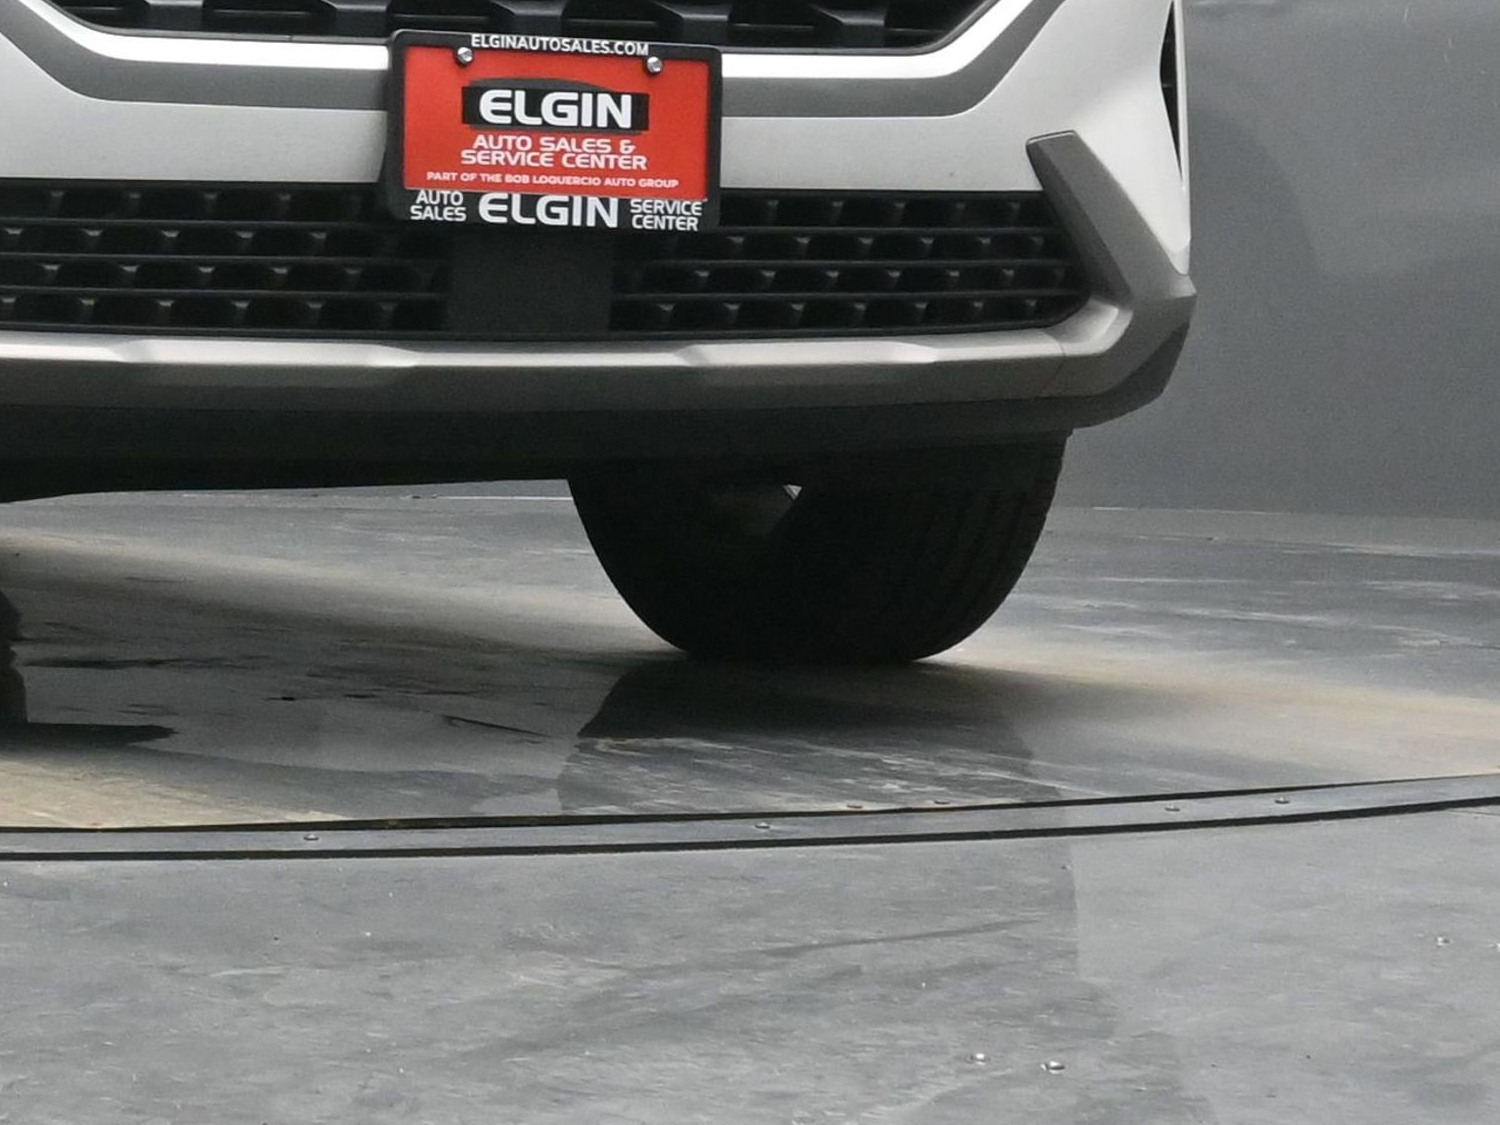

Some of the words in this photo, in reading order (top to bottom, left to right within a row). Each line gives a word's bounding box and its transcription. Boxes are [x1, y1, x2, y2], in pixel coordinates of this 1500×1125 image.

[471, 34, 649, 57] ELGINAUTOSALES.COM
[478, 88, 633, 130] ELGIN
[472, 134, 532, 151] AUTO
[539, 136, 612, 155] SALES
[619, 138, 636, 154] &
[460, 150, 555, 168] SERVICE
[561, 152, 648, 171] CENTER
[426, 171, 458, 182] PART
[460, 172, 477, 182] OF
[479, 172, 502, 183] THE
[504, 173, 530, 184] BOB
[532, 175, 601, 187] LOQUERCIO
[603, 177, 636, 188] AUTO
[638, 178, 679, 189] GROUP
[415, 190, 464, 206] AUTO
[629, 198, 703, 216] SERVICE
[409, 205, 468, 222] SALES
[478, 192, 619, 229] ELGIN
[631, 214, 700, 232] CENTER
